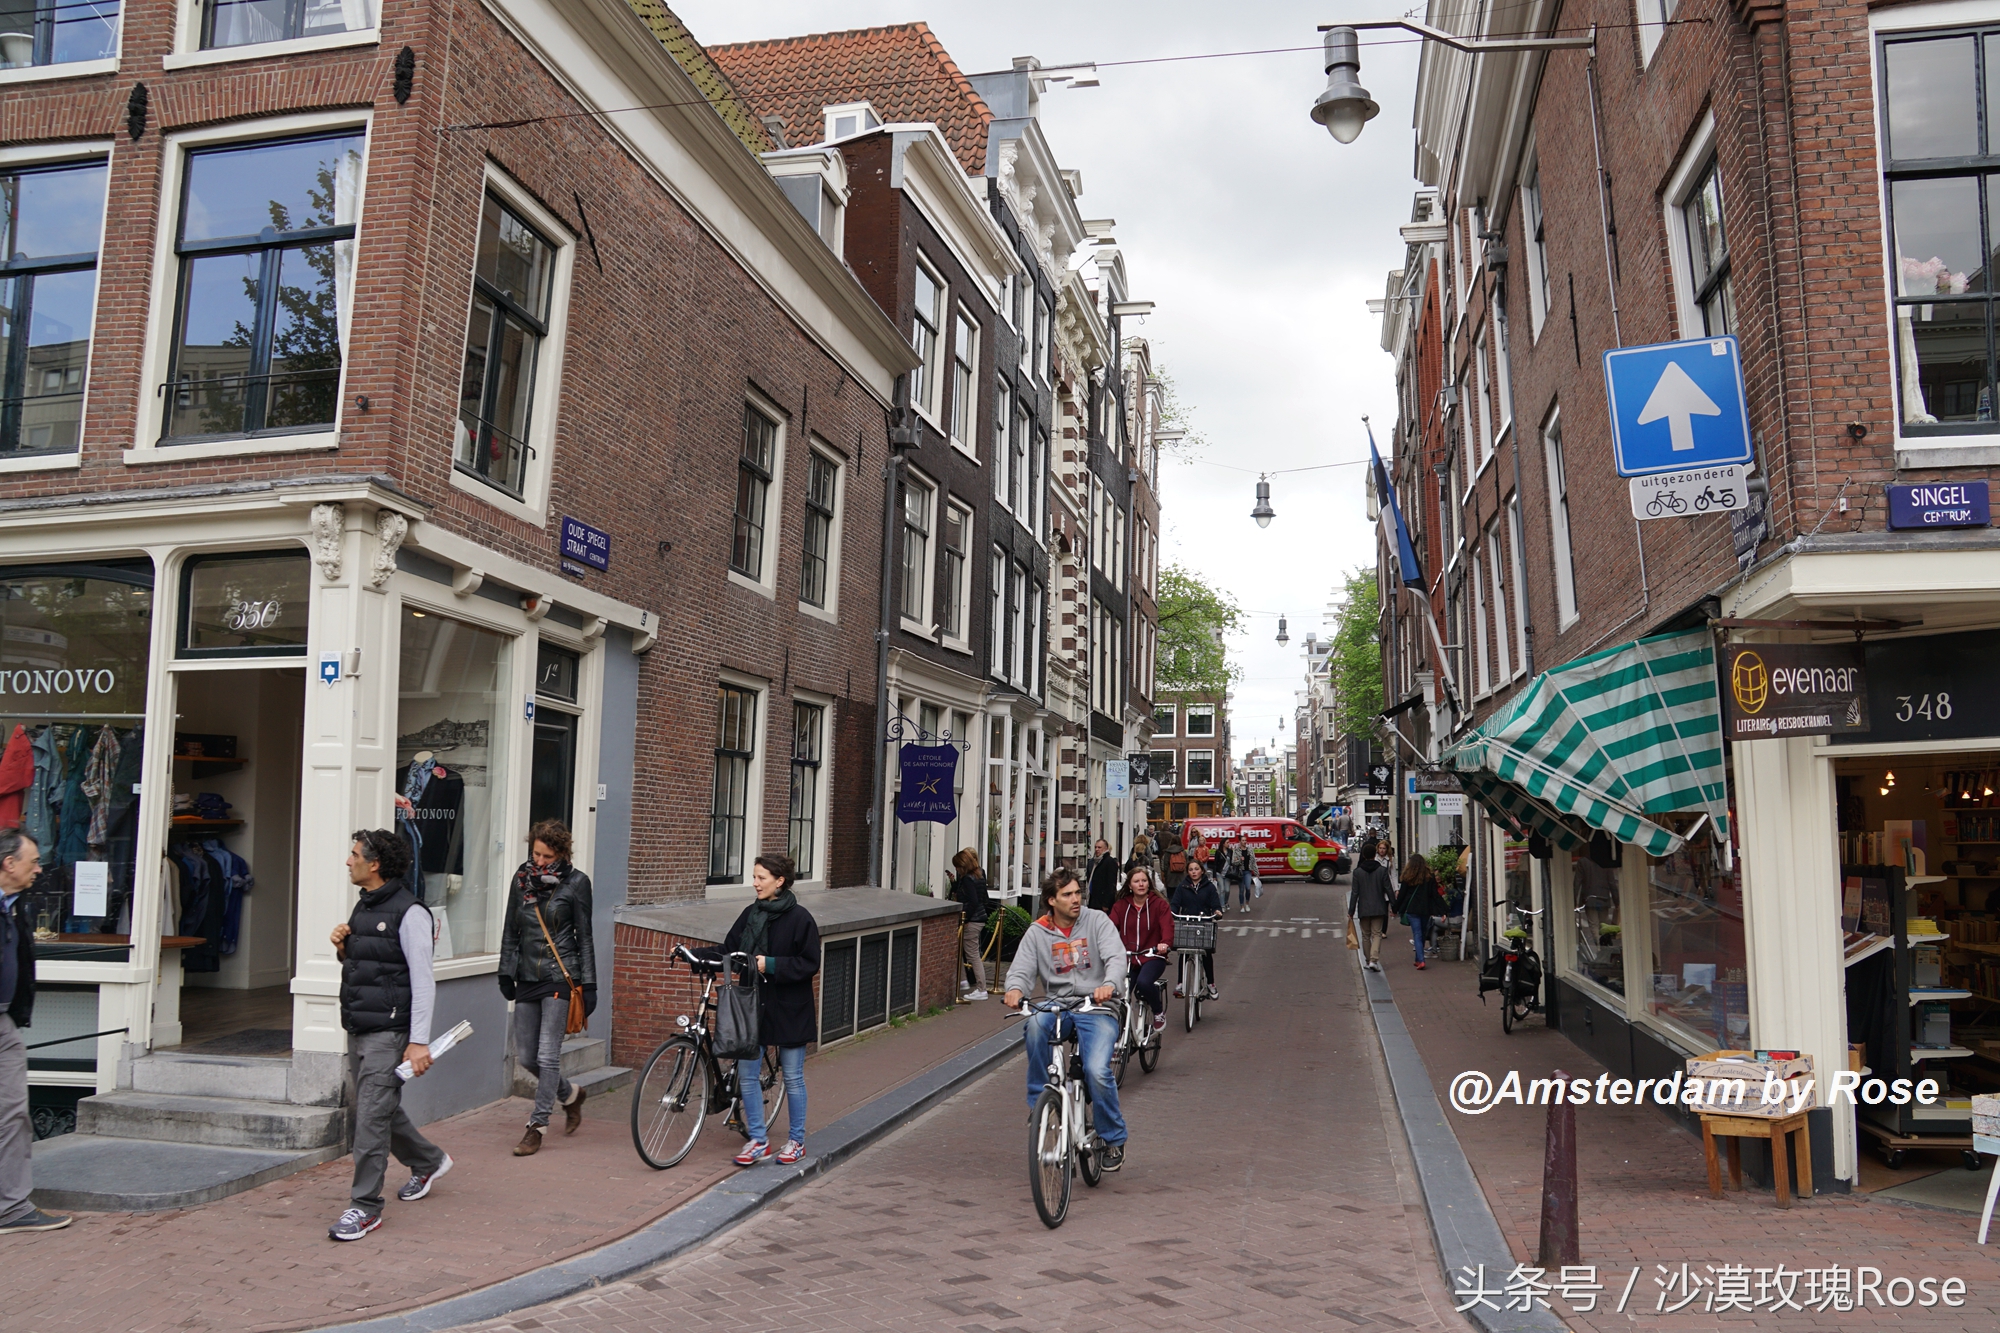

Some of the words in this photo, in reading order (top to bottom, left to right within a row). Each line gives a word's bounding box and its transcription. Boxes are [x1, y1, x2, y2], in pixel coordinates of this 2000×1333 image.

[1641, 467, 1734, 488] uitgezonderd
[1911, 486, 1971, 507] SINGEL
[568, 523, 586, 541] OUDE
[586, 531, 607, 550] SPIEGEL
[1734, 526, 1751, 550] STRAAT
[566, 538, 588, 557] STRAAT
[589, 552, 606, 565] CENTRUM
[229, 600, 280, 631] 350
[1772, 667, 1858, 695] evenaar
[1895, 692, 1953, 722] 348
[1736, 717, 1771, 733] LITERAIRE
[1778, 714, 1833, 730] REISBOEKHANDEL
[396, 808, 456, 820] PORTONOVO
[1713, 1066, 1753, 1078] Amsterdam
